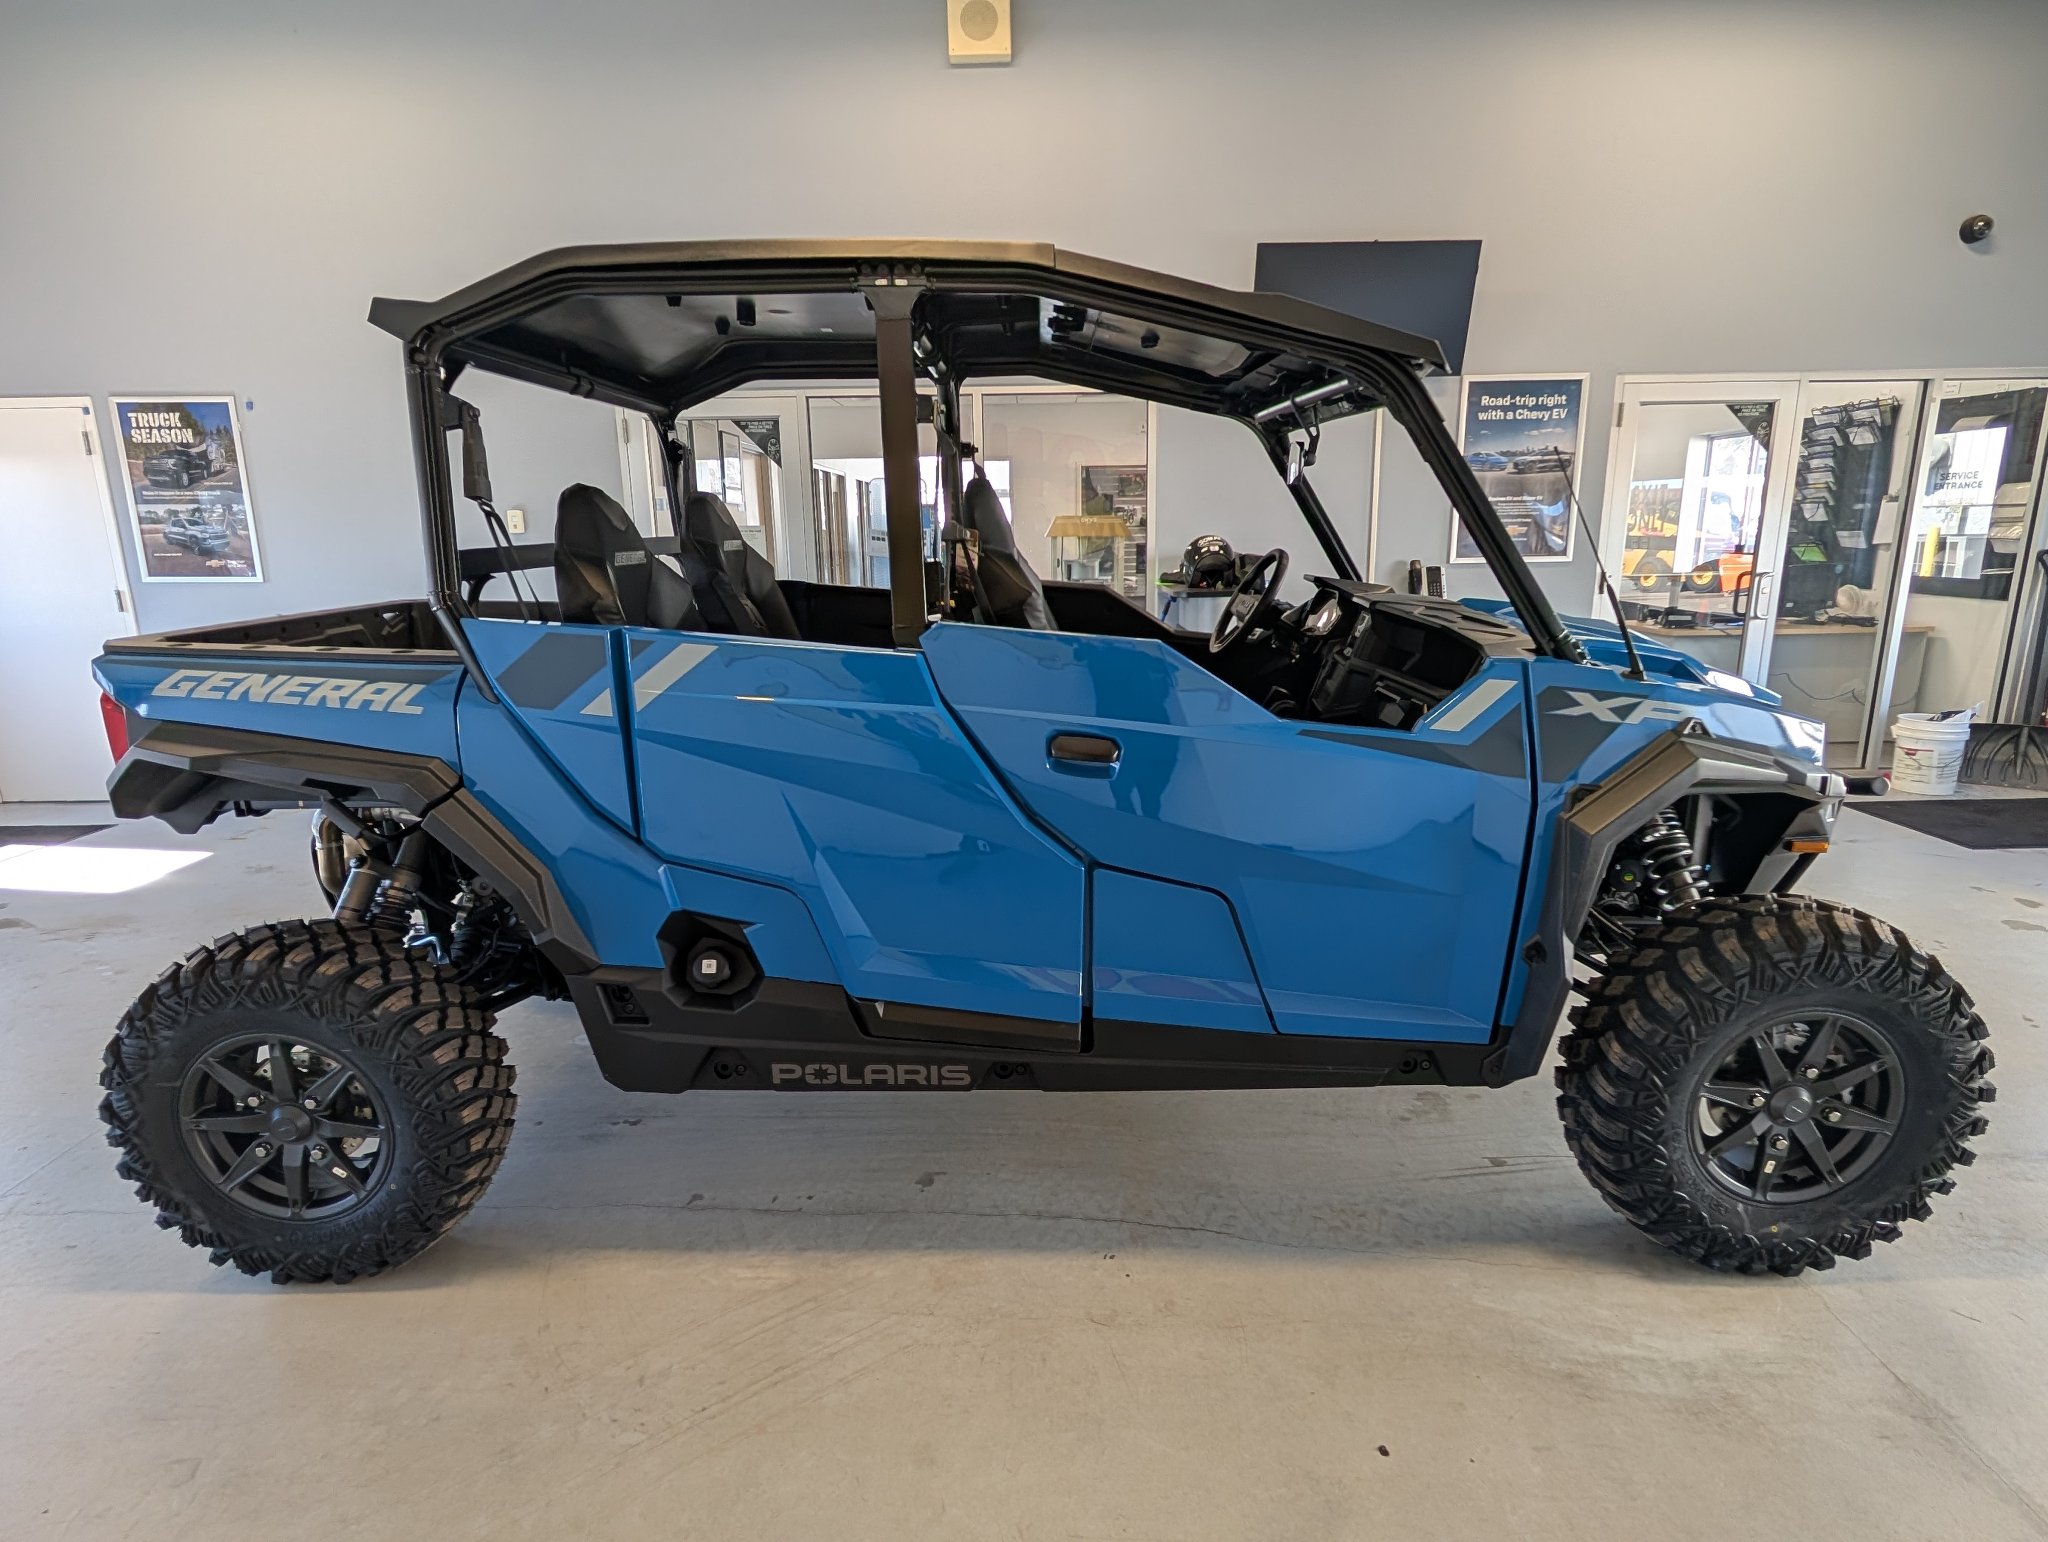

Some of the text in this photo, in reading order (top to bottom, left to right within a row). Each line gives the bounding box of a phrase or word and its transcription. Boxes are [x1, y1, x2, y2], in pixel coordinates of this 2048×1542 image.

[1481, 394, 1567, 407] Road-trip right
[127, 412, 181, 428] TRUCK
[1478, 408, 1568, 421] with a Chevy EV
[131, 428, 194, 443] SEASON
[1939, 471, 1980, 481] SERVICE
[1934, 480, 1983, 490] ENTRANCE
[151, 669, 427, 715] GENERAL
[1545, 690, 1700, 724] XP
[771, 1063, 972, 1086] POLARIS
